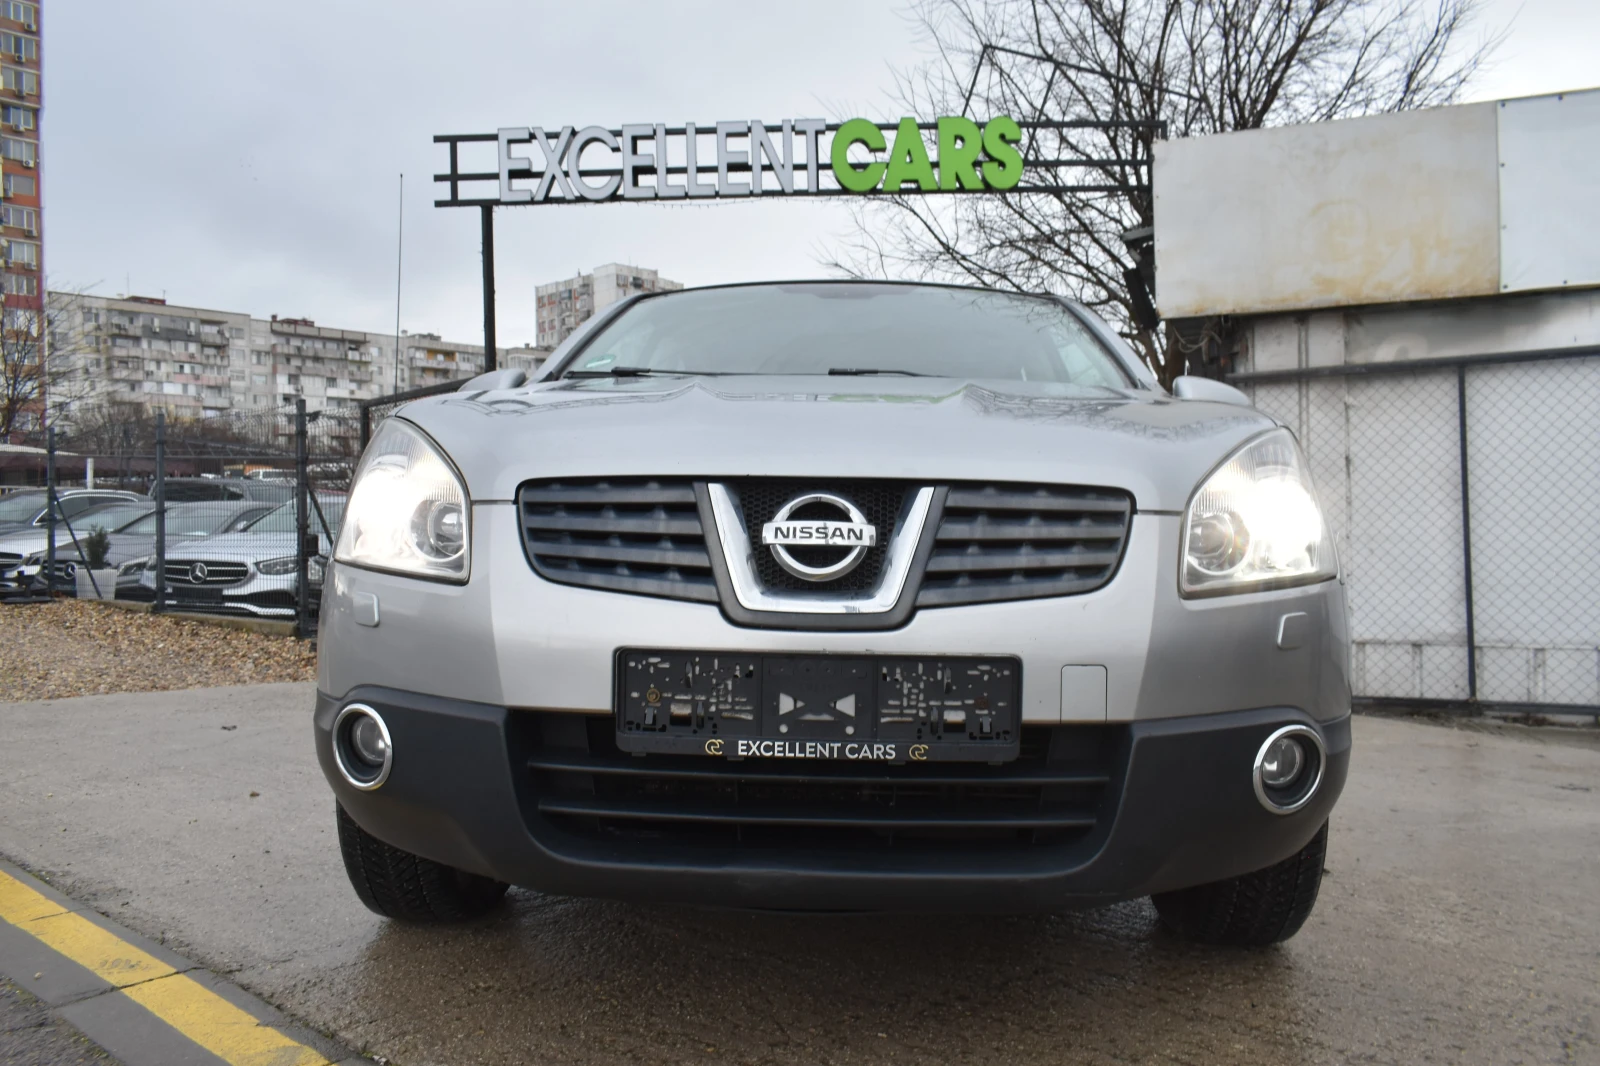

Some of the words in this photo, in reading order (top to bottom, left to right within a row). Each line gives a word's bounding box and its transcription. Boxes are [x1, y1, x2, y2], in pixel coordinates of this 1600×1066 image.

[774, 526, 864, 541] NISSAN
[737, 740, 842, 758] EXCELLENT
[845, 743, 896, 760] CARS
